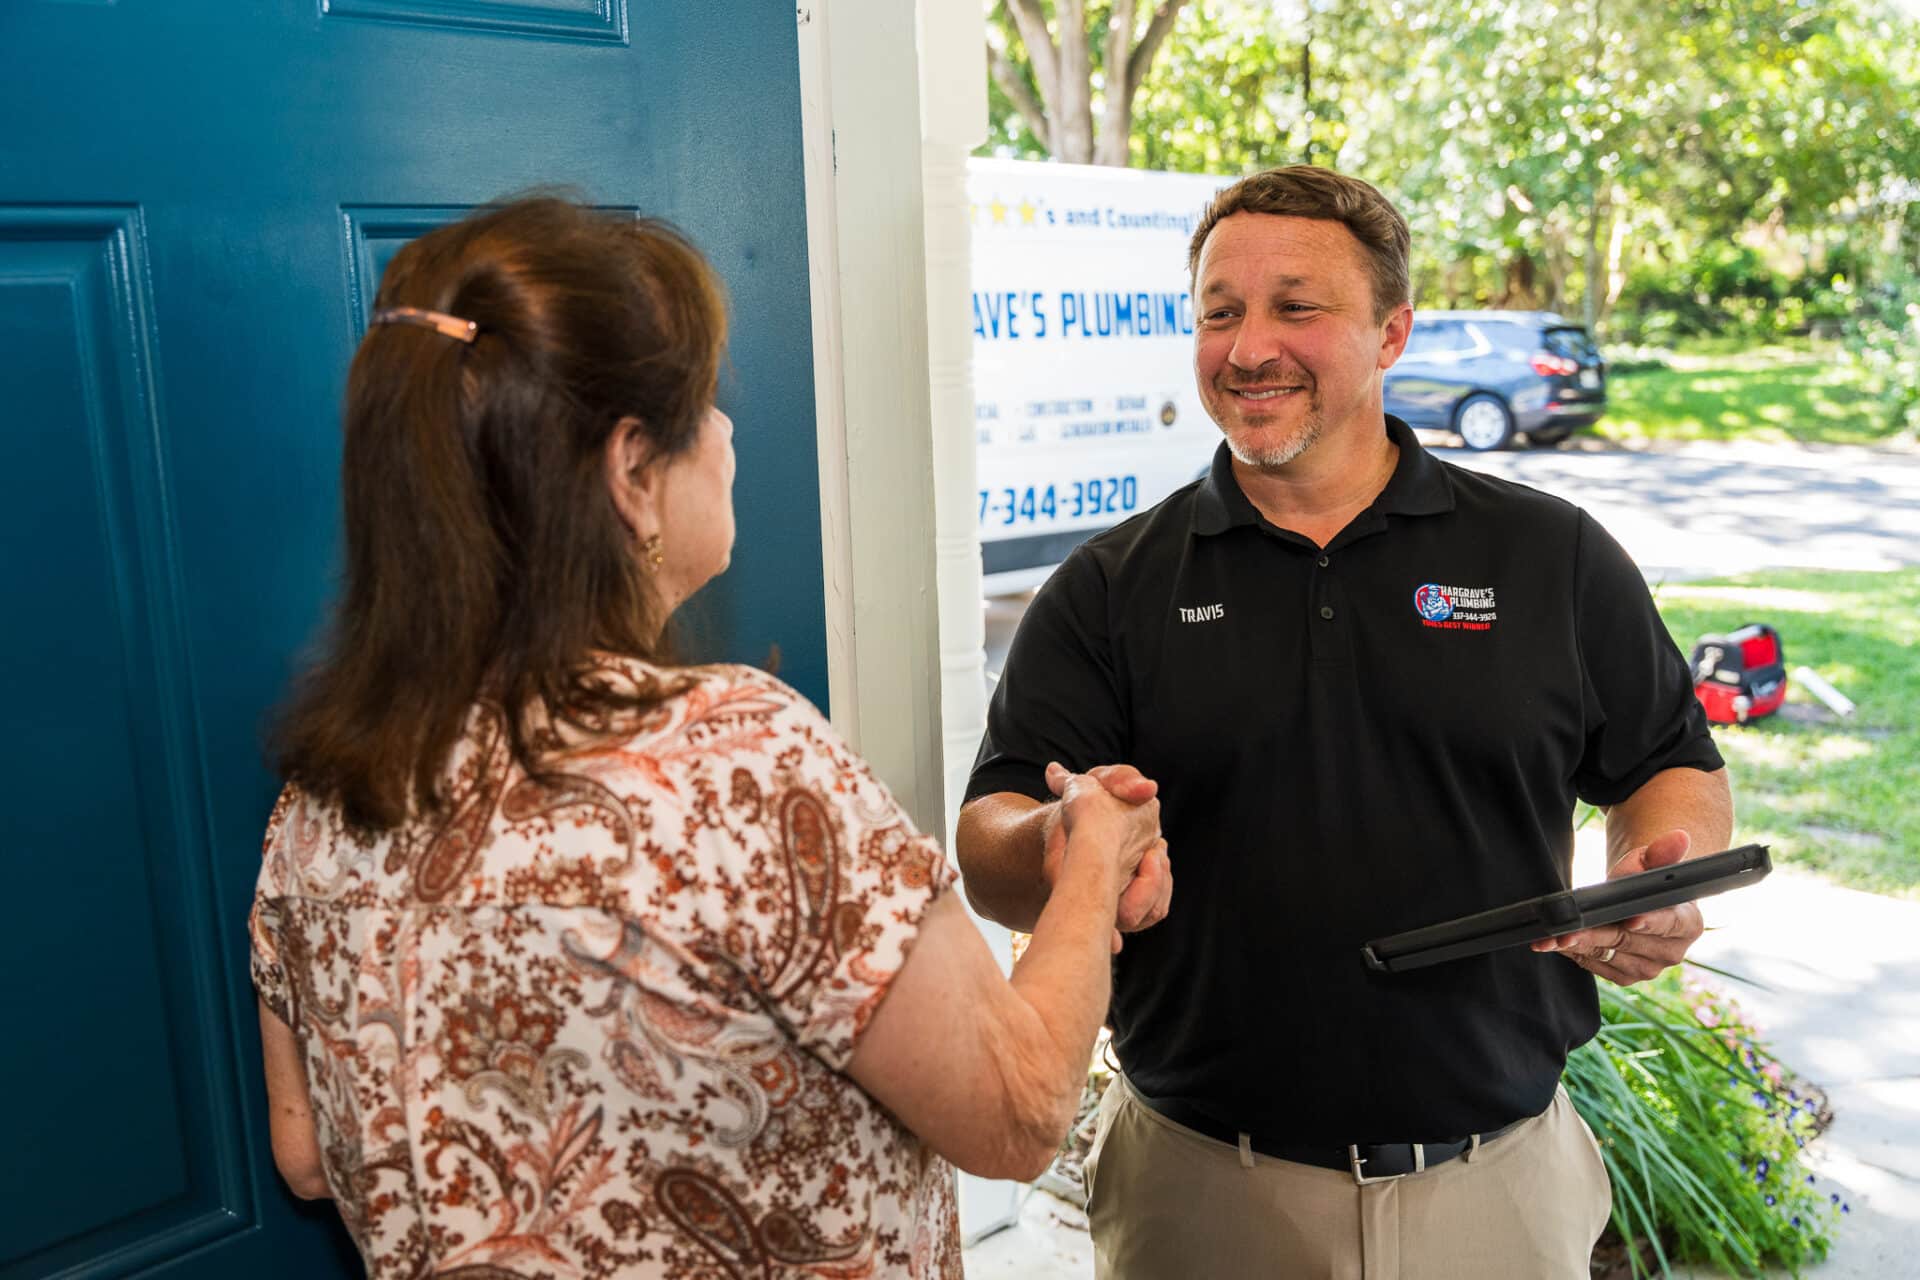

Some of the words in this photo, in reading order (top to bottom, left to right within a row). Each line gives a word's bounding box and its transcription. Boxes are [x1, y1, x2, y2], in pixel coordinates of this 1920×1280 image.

[1066, 208, 1100, 227] and
[1061, 292, 1193, 337] PLUMBING
[979, 475, 1137, 525] 7-344-3920
[1440, 585, 1494, 598] HARGRAVE'S
[1450, 597, 1496, 608] PLUMBING
[1179, 603, 1225, 623] TRAVIS
